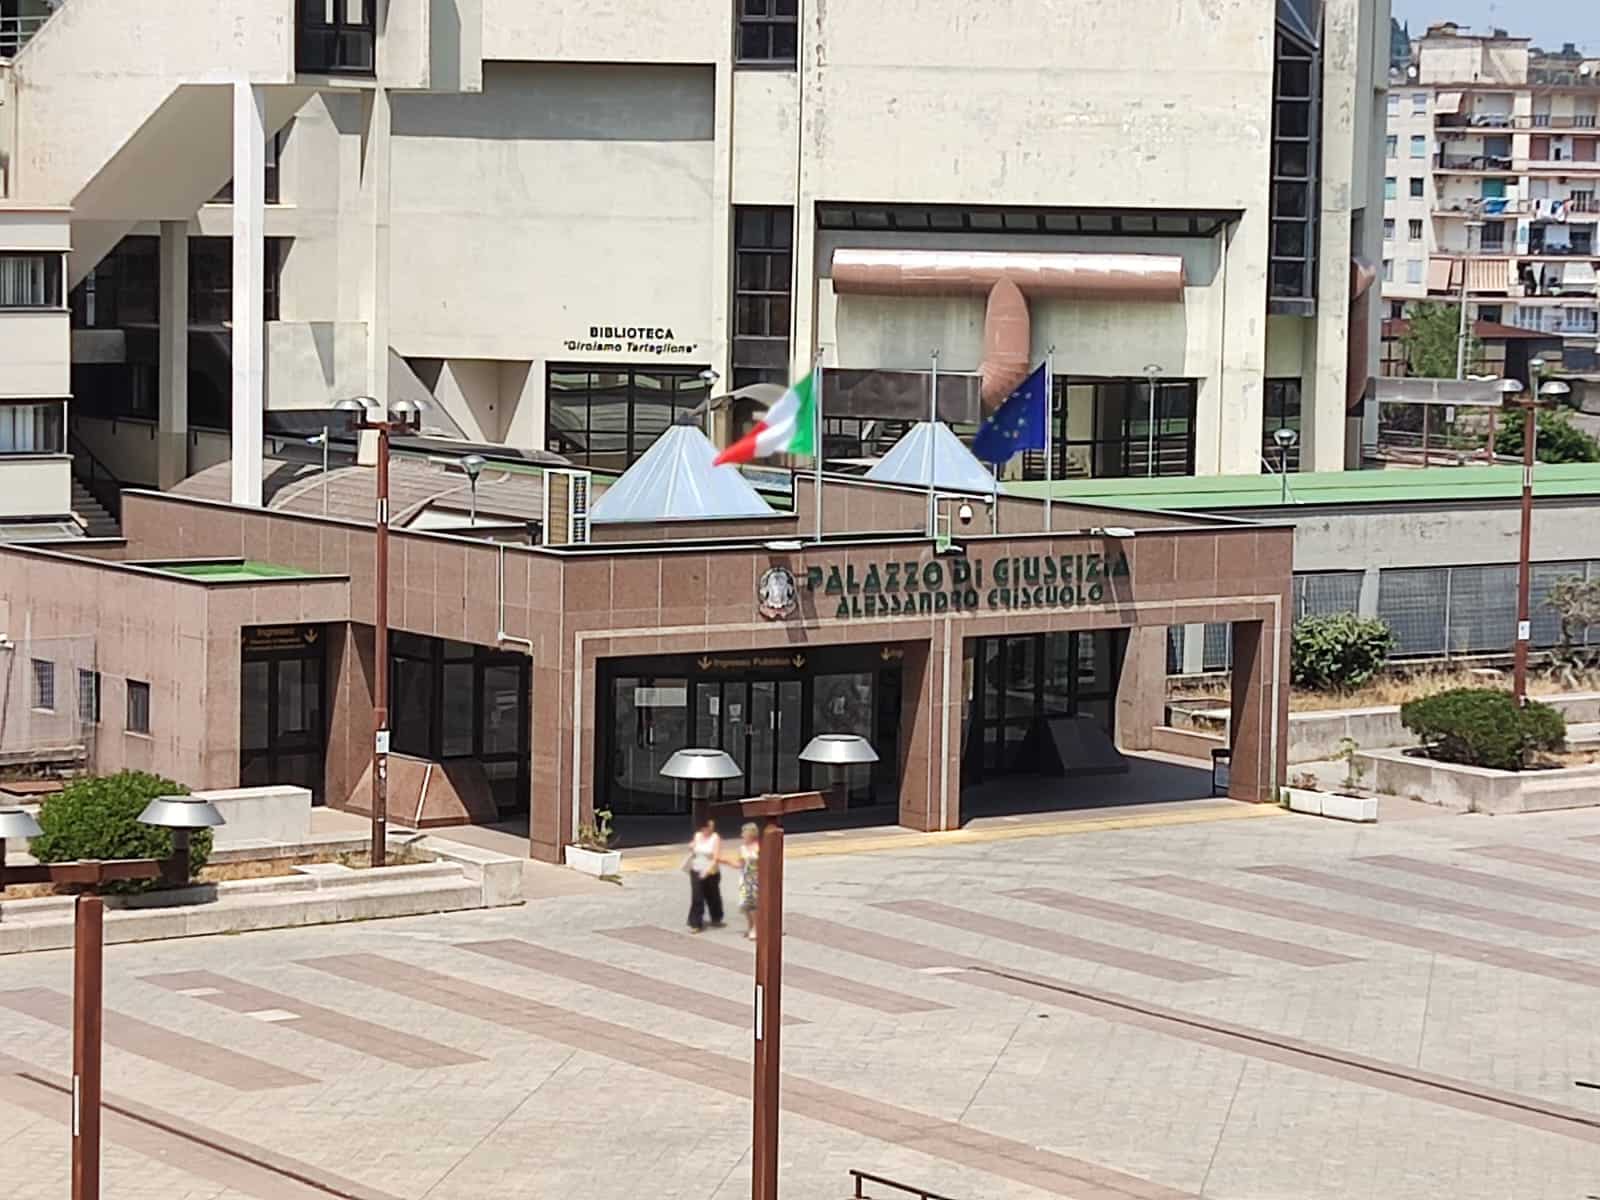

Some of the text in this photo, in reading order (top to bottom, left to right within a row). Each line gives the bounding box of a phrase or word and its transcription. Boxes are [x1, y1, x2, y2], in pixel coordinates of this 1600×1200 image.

[590, 326, 675, 340] BIBLIOTECA
[807, 552, 1131, 594] PALAZZO DI GIUSTIZIA
[836, 584, 1104, 618] ALESSANDRO CRISCUOLO
